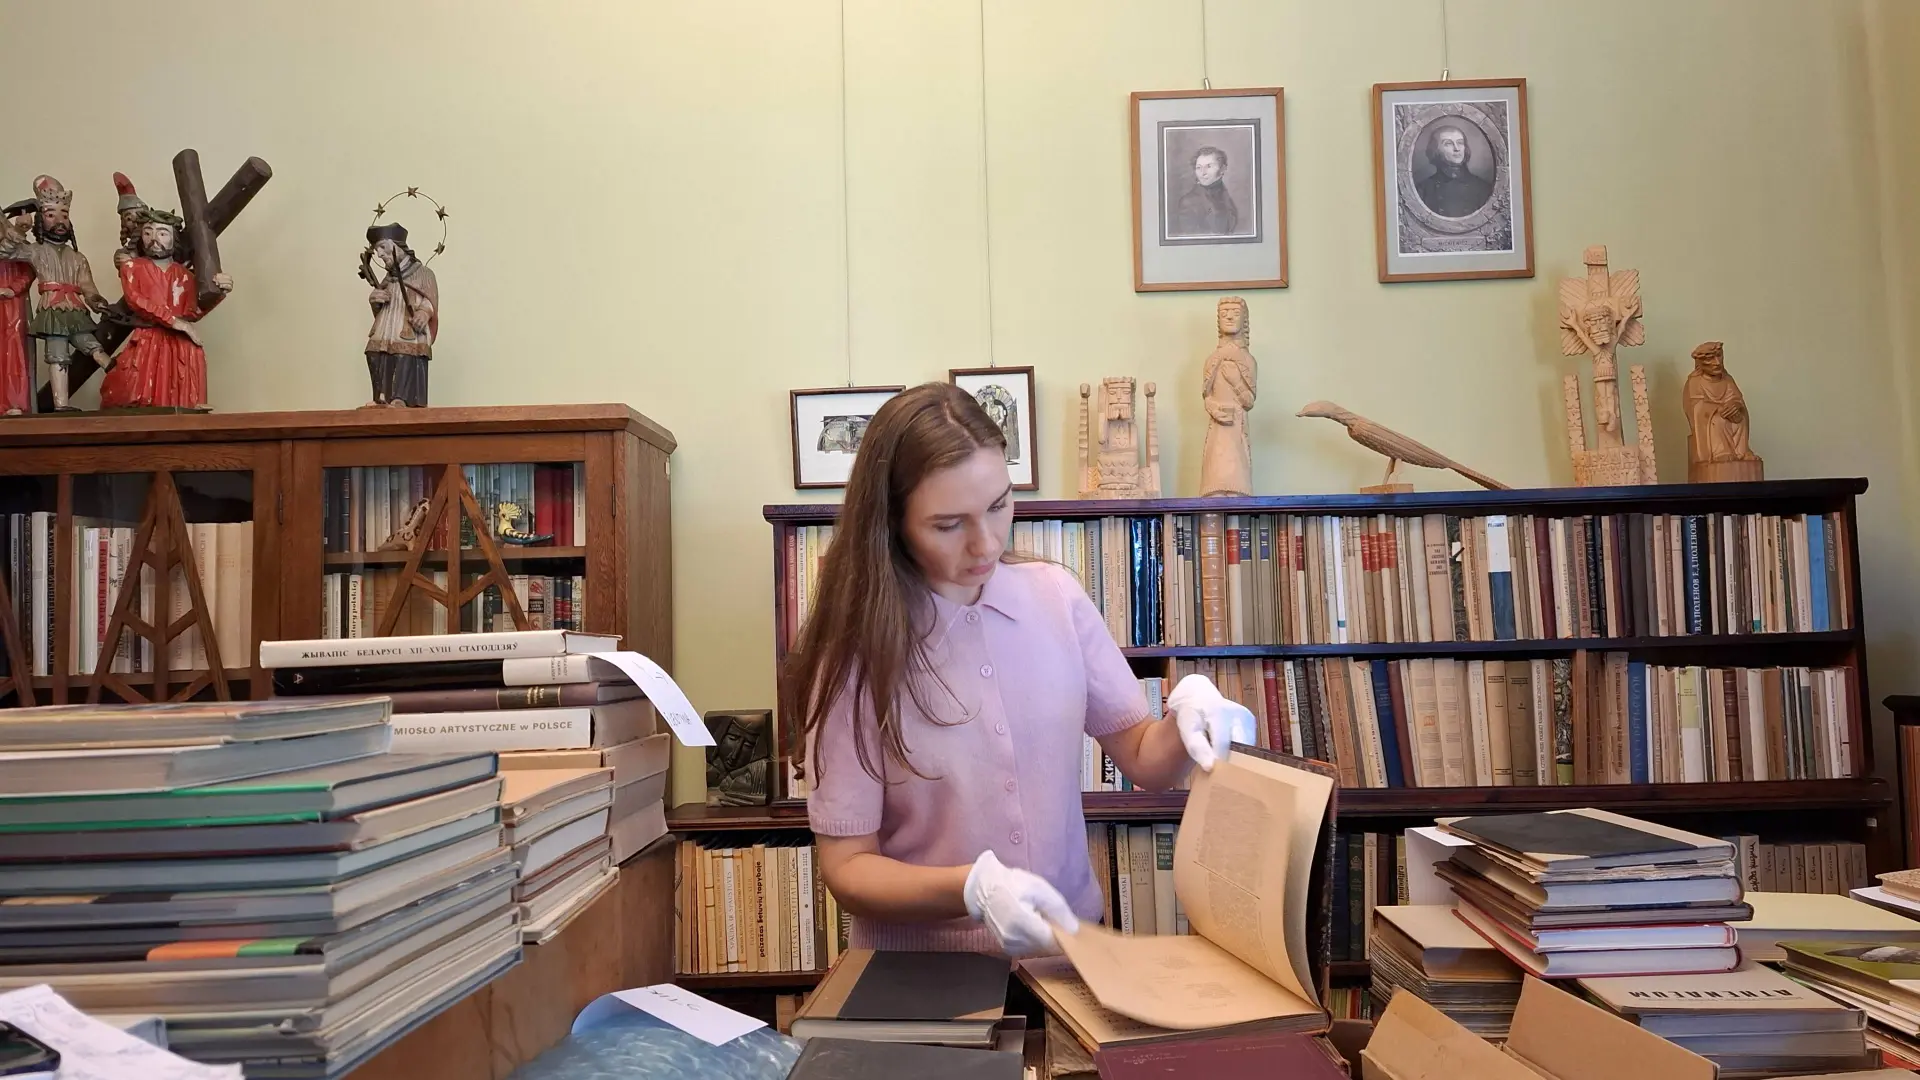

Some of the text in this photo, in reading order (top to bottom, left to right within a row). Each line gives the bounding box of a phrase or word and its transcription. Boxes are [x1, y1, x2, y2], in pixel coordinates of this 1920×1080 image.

[357, 648, 402, 657] БЕЛАРУСІ
[393, 721, 573, 737] MIOSŁO ARTYSTYCZNE w POLSCE
[1628, 988, 1794, 999] ATHENAEUM
